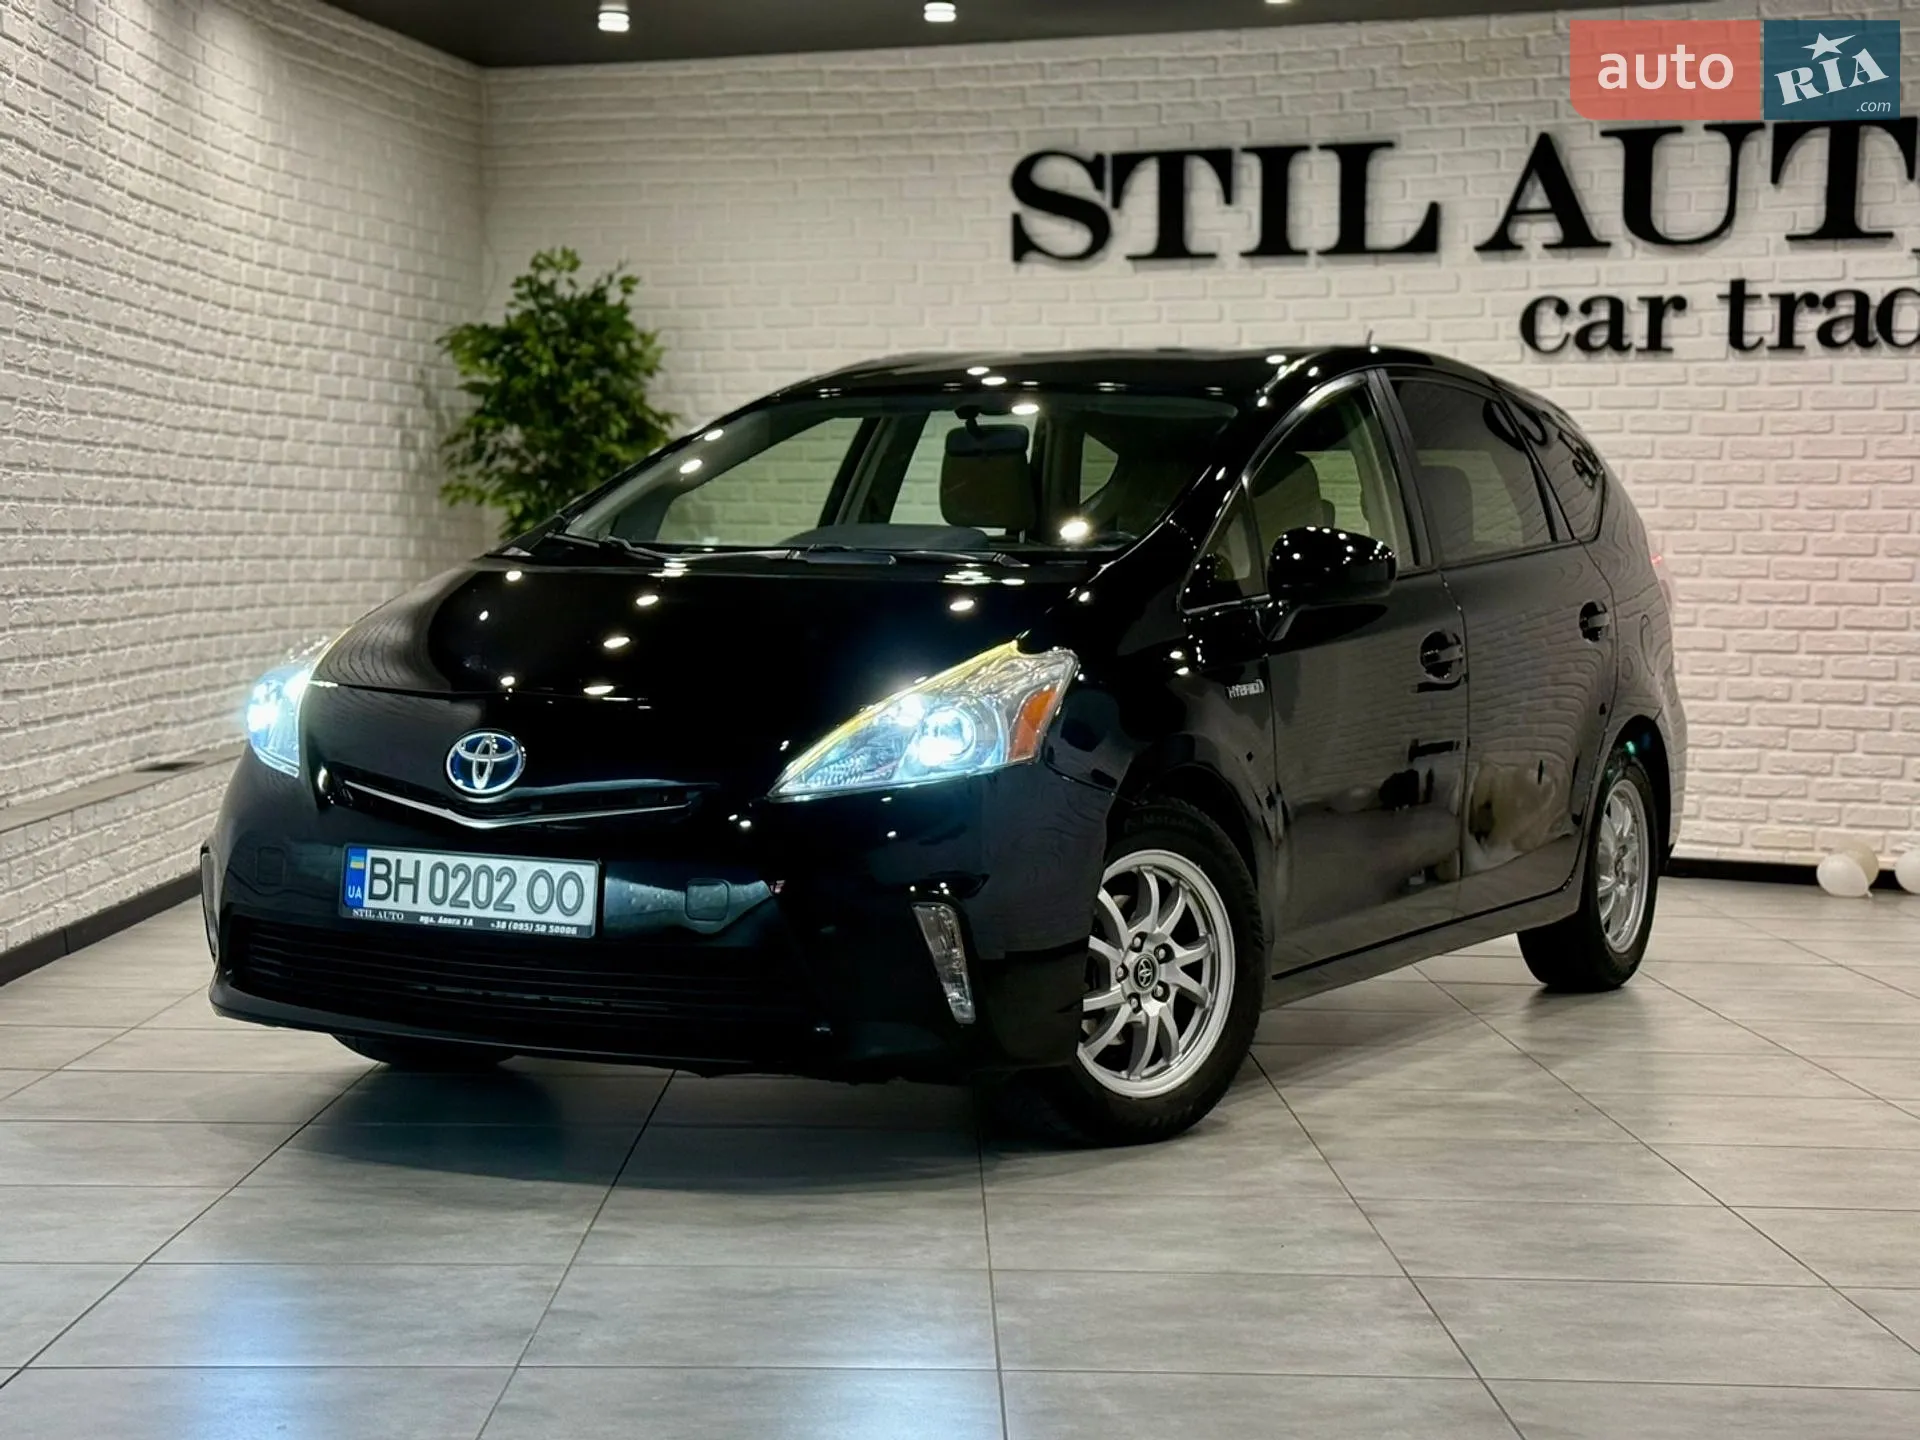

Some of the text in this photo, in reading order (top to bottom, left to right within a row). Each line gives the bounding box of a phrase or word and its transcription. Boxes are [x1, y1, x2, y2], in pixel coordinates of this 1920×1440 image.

[1011, 141, 1441, 262] STIL
[1520, 295, 1687, 353] car
[347, 886, 363, 900] UA
[367, 857, 421, 904] BH
[428, 862, 517, 912] 0202
[352, 908, 404, 921] STIL AUTO
